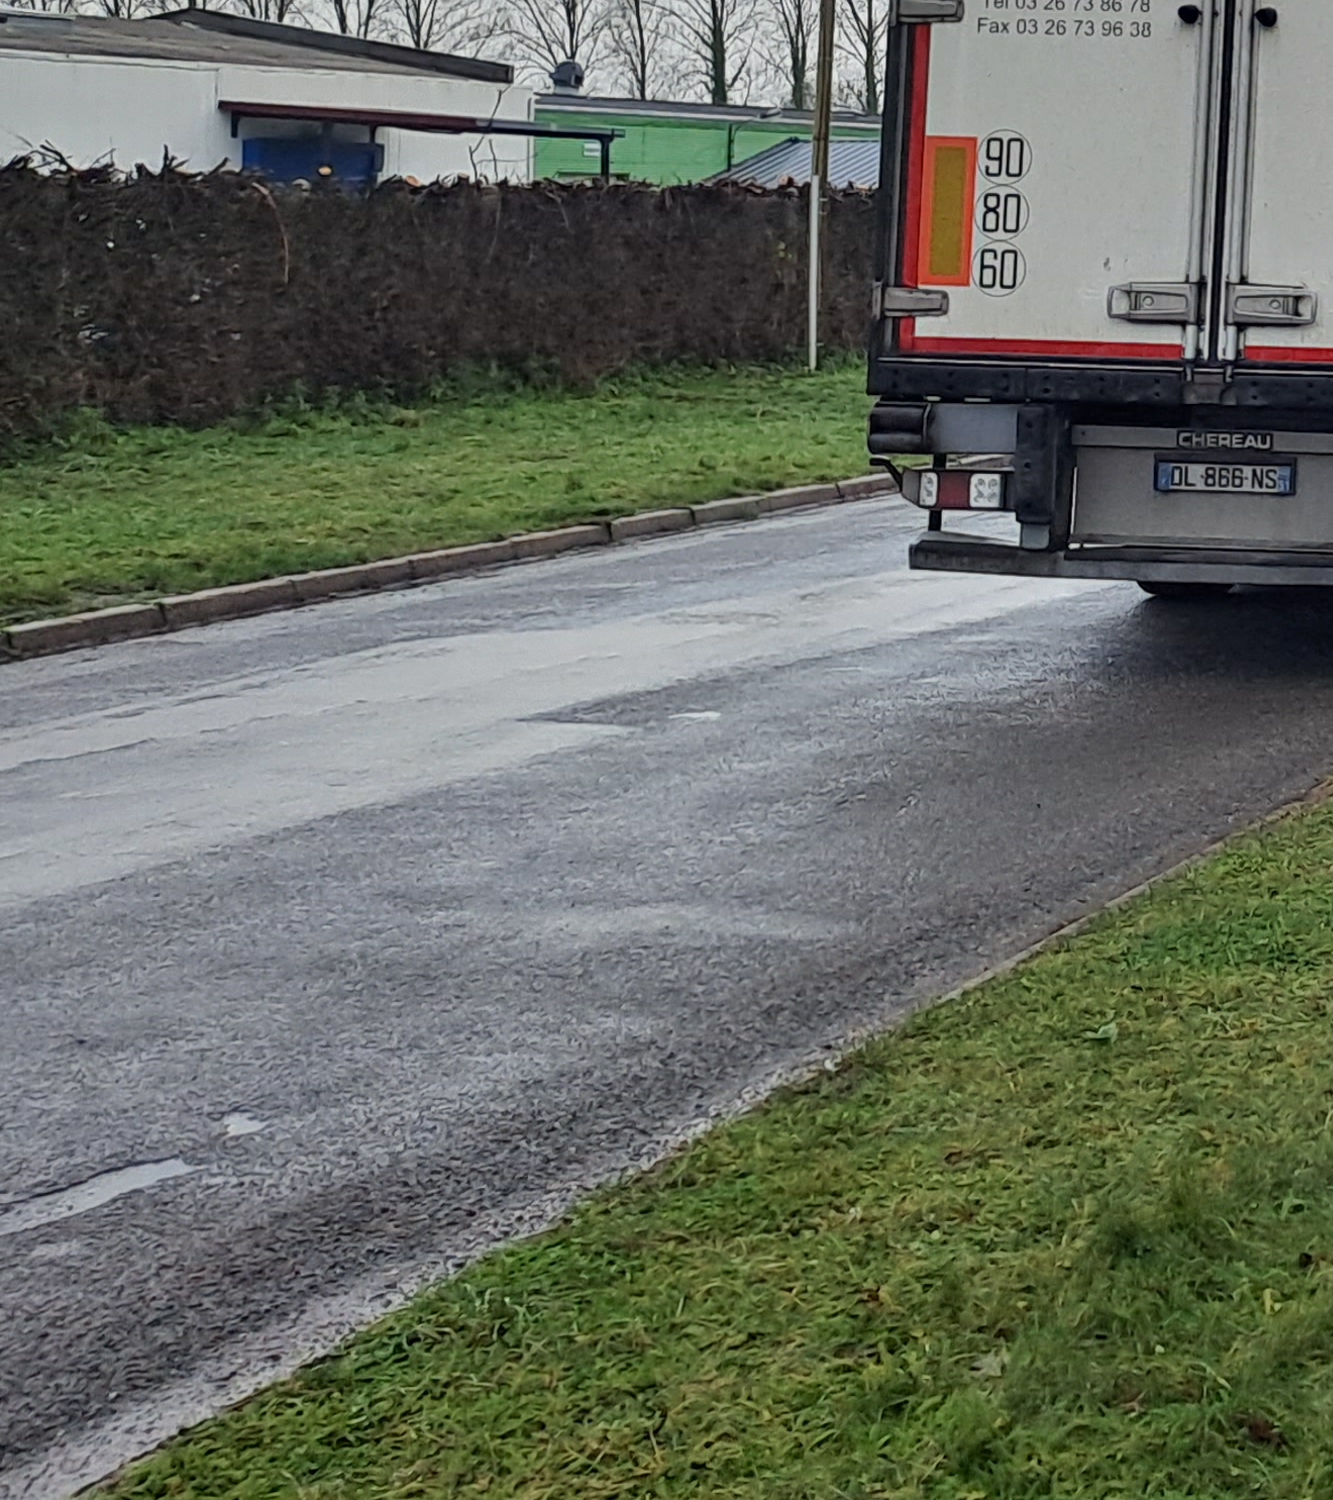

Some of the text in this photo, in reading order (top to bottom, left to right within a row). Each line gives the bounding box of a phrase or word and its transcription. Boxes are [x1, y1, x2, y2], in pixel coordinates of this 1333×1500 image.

[977, 17, 1152, 38] Fax 03 26 73 96 38
[985, 137, 1024, 177] 90
[982, 193, 1021, 233] 80
[979, 248, 1018, 289] 60
[1178, 432, 1271, 449] CHEREAU
